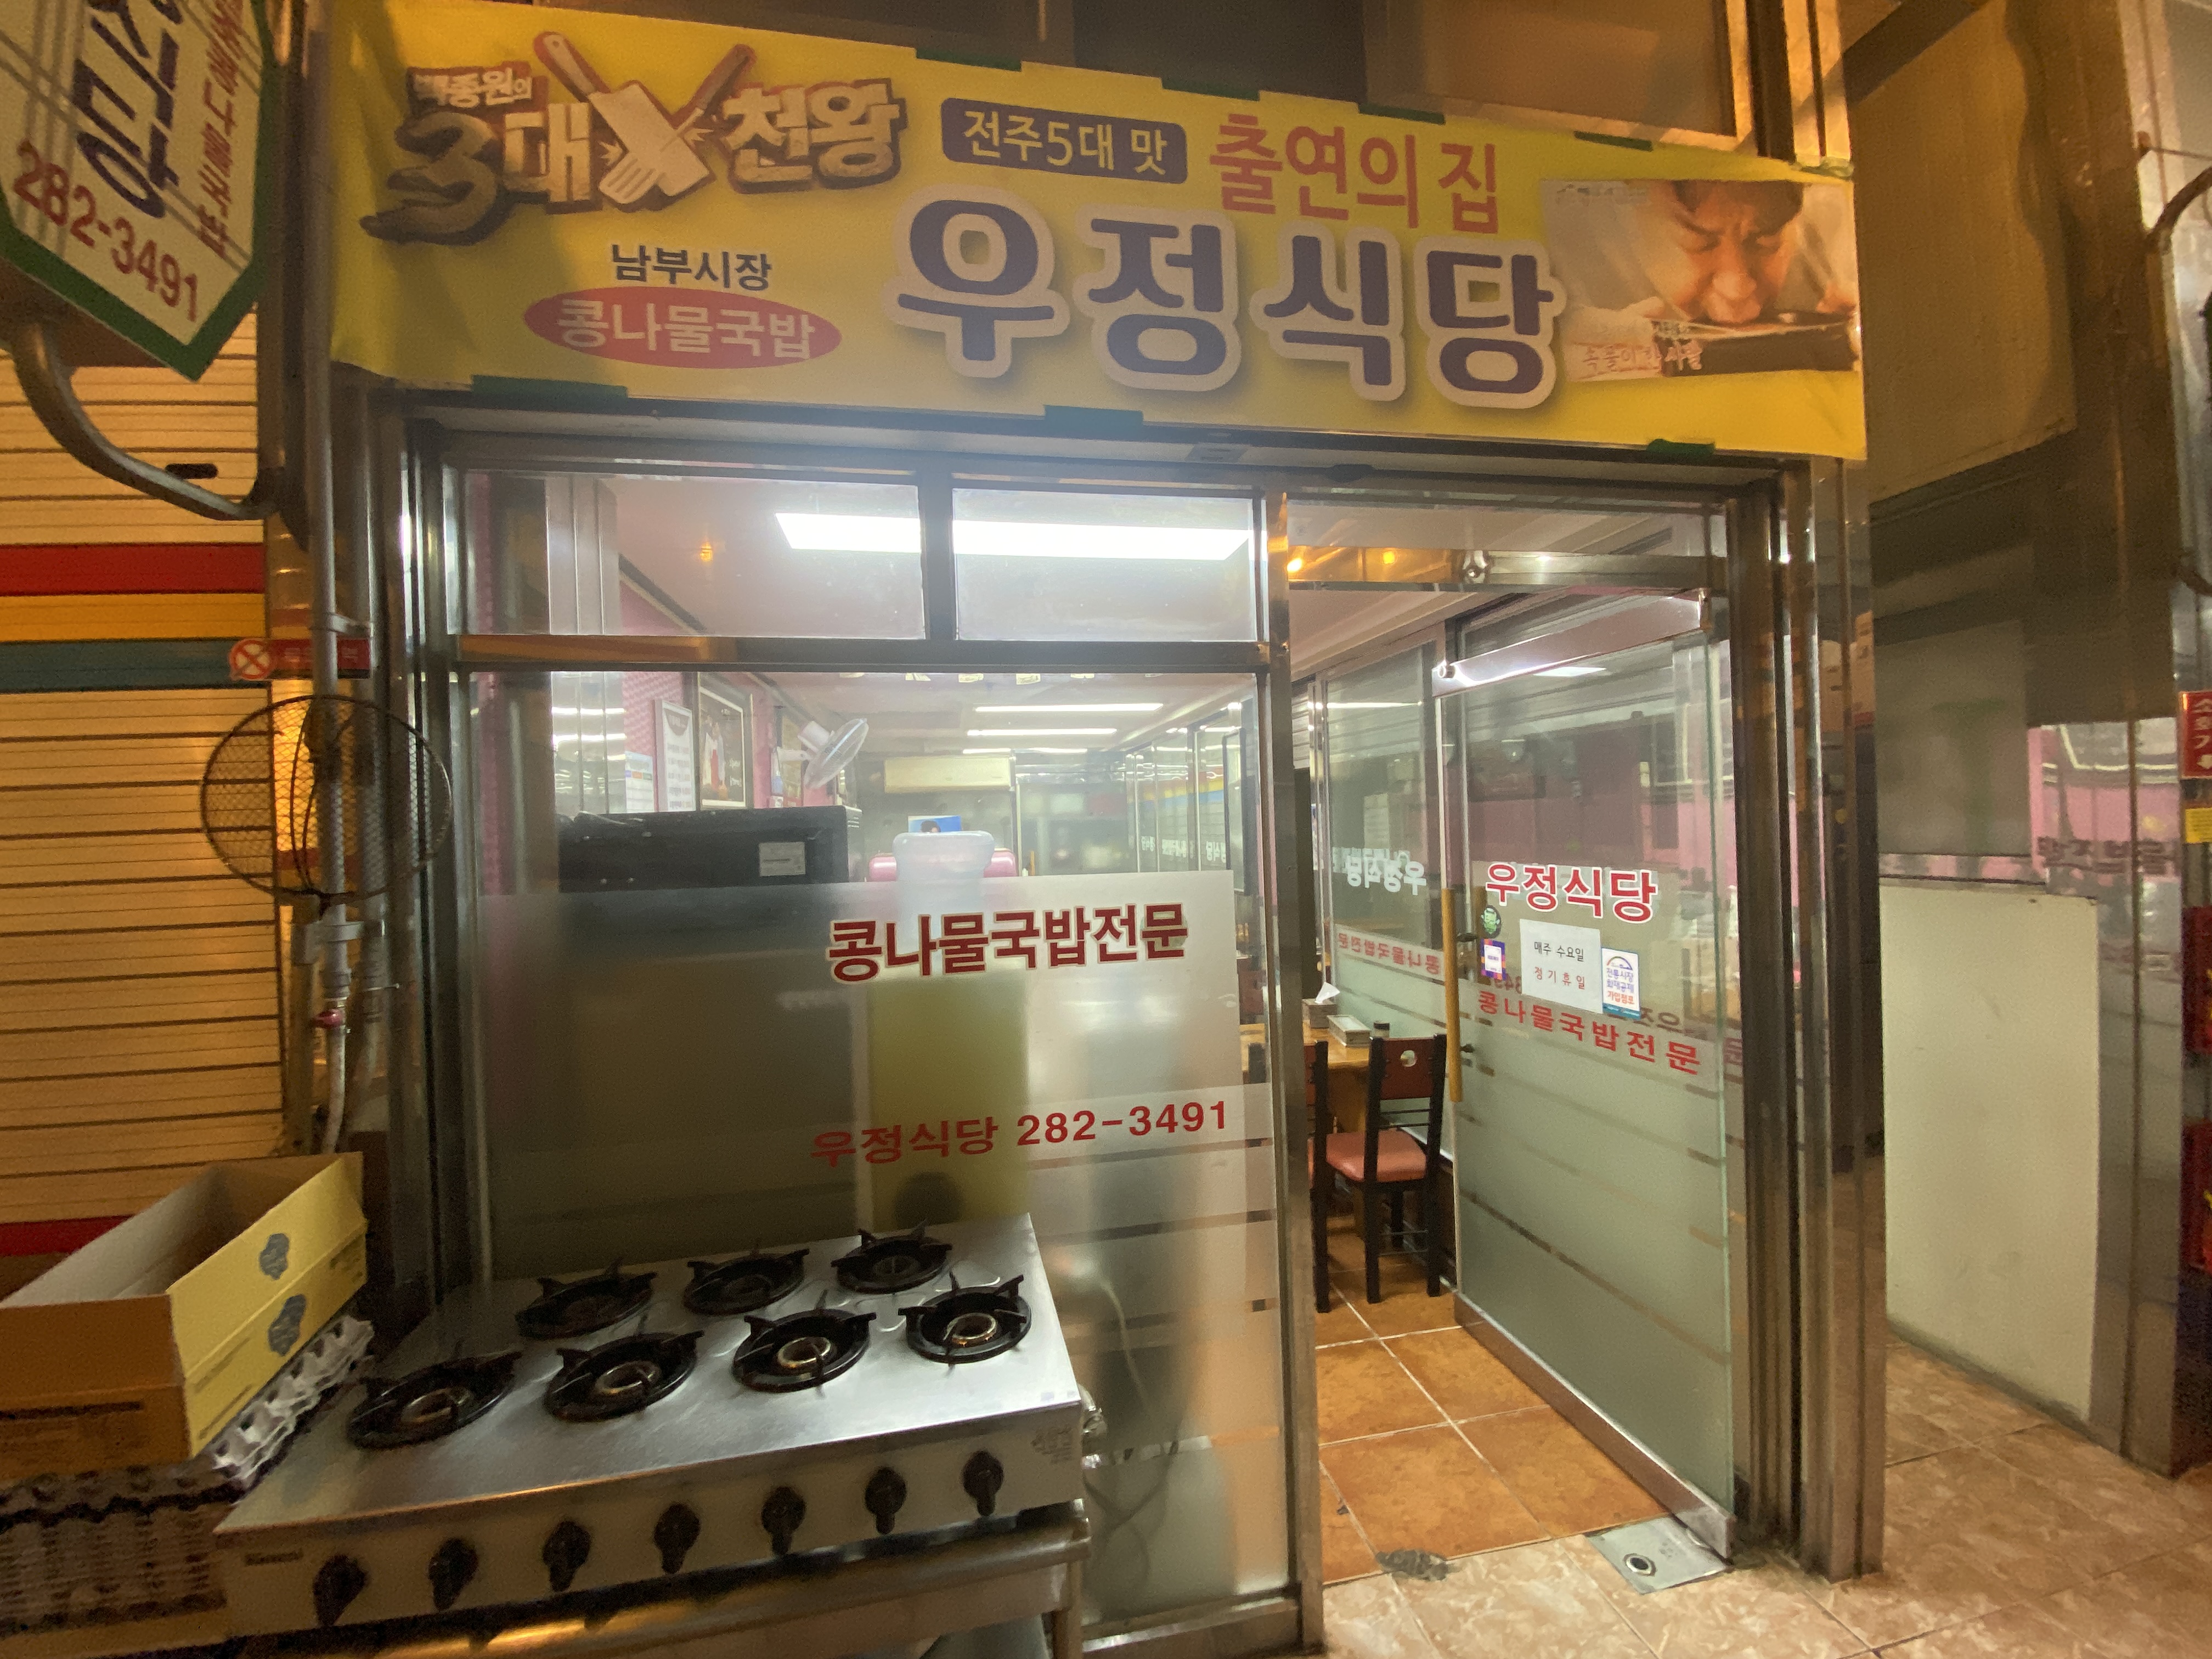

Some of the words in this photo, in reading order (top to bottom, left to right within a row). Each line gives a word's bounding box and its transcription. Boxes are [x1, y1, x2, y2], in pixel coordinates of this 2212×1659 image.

[722, 82, 901, 184] 천왕
[962, 110, 1115, 170] 전주5대
[1130, 128, 1167, 176] 맛
[1438, 140, 1499, 234] 집
[13, 137, 198, 322] 282-3491
[611, 244, 772, 291] 남부시장
[895, 198, 1555, 396] 우정식당
[555, 298, 816, 359] 콩나물국밥
[1485, 862, 1658, 924] 우정식당
[827, 902, 1189, 983] 콩나물국밥전문
[1533, 941, 1552, 956] 매주
[1556, 945, 1584, 963] 수요일
[1606, 967, 1634, 983] 전통시장
[1477, 990, 1701, 1075] 콩나물국밥전문
[810, 1116, 998, 1169] 우정식당
[1016, 1100, 1227, 1147] 282-3491
